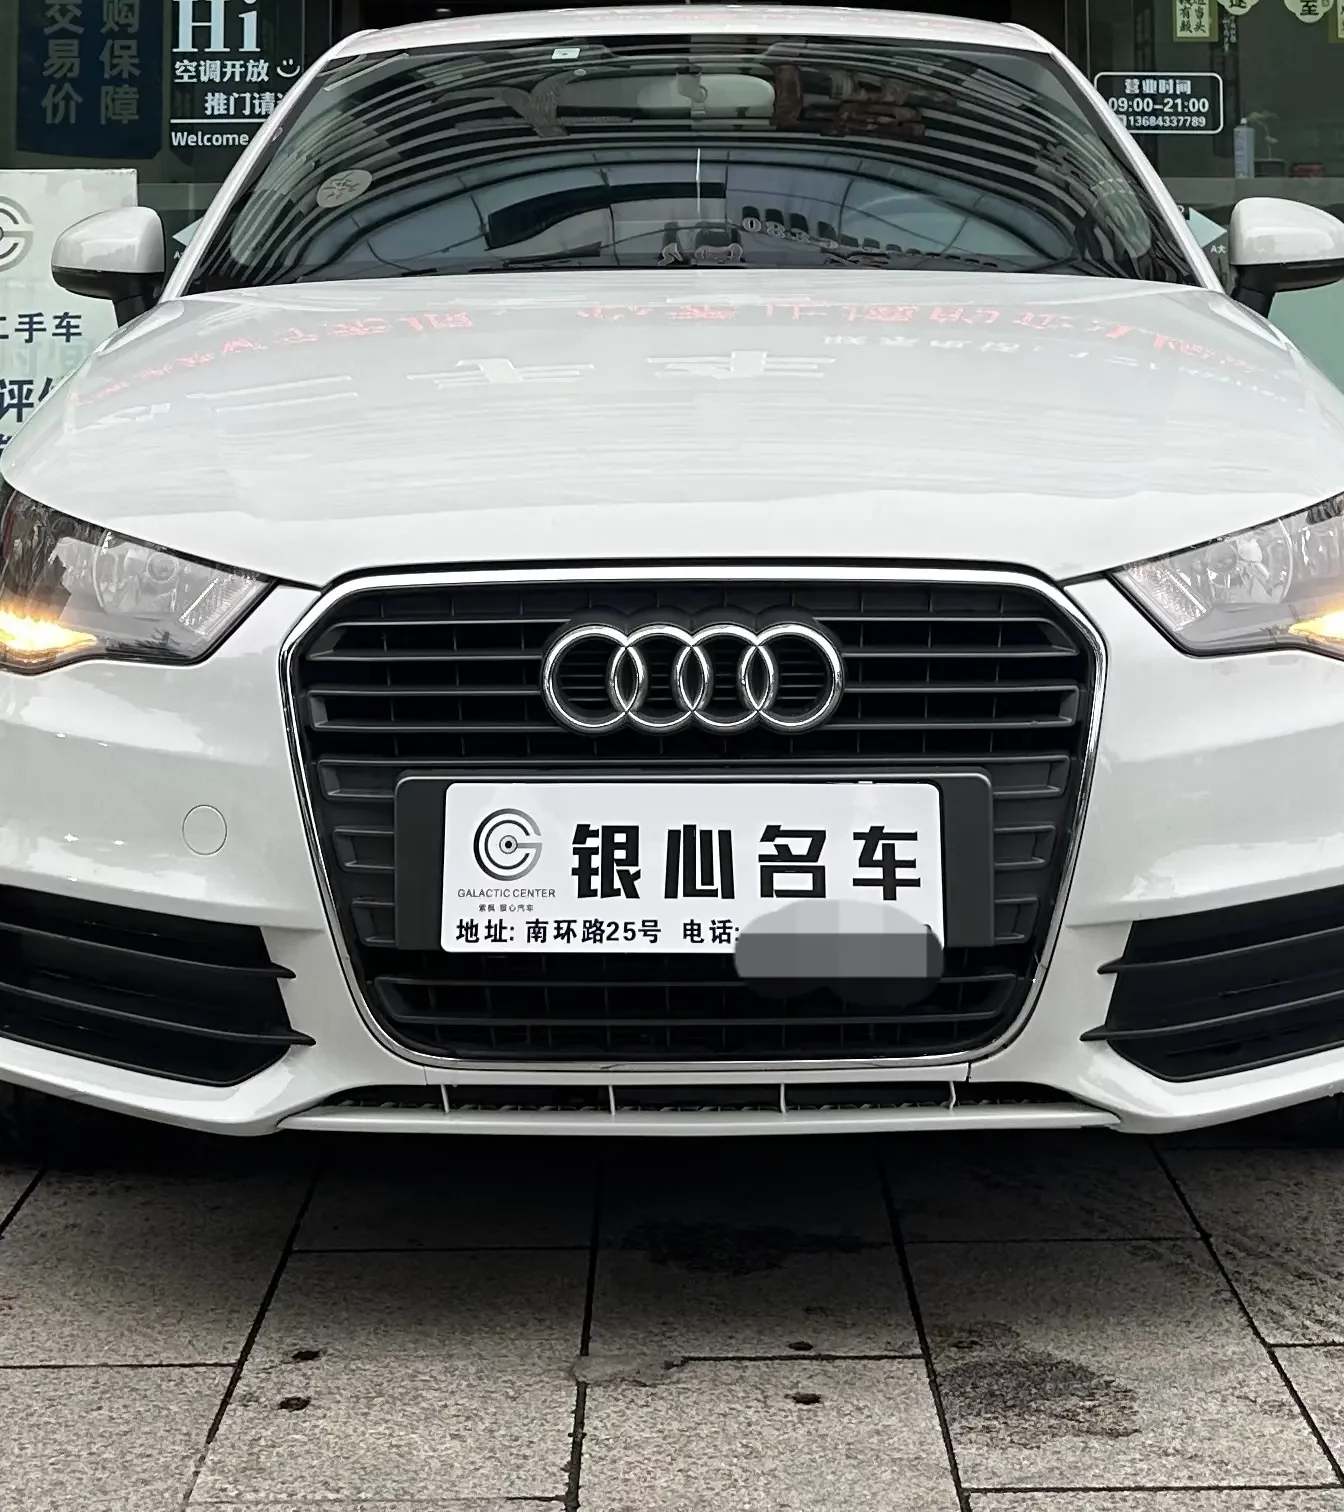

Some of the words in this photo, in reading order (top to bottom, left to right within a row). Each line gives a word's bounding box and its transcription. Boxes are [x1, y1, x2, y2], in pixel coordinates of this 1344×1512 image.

[174, 60, 270, 83] 空调开放
[1124, 78, 1192, 95] 营业时间
[1128, 116, 1206, 128] 13684337789
[171, 131, 249, 147] Welcome
[571, 823, 922, 901] 银心名车
[457, 888, 511, 898] GALACTIC
[512, 888, 556, 898] CENTER
[525, 918, 662, 944] 南环路25号
